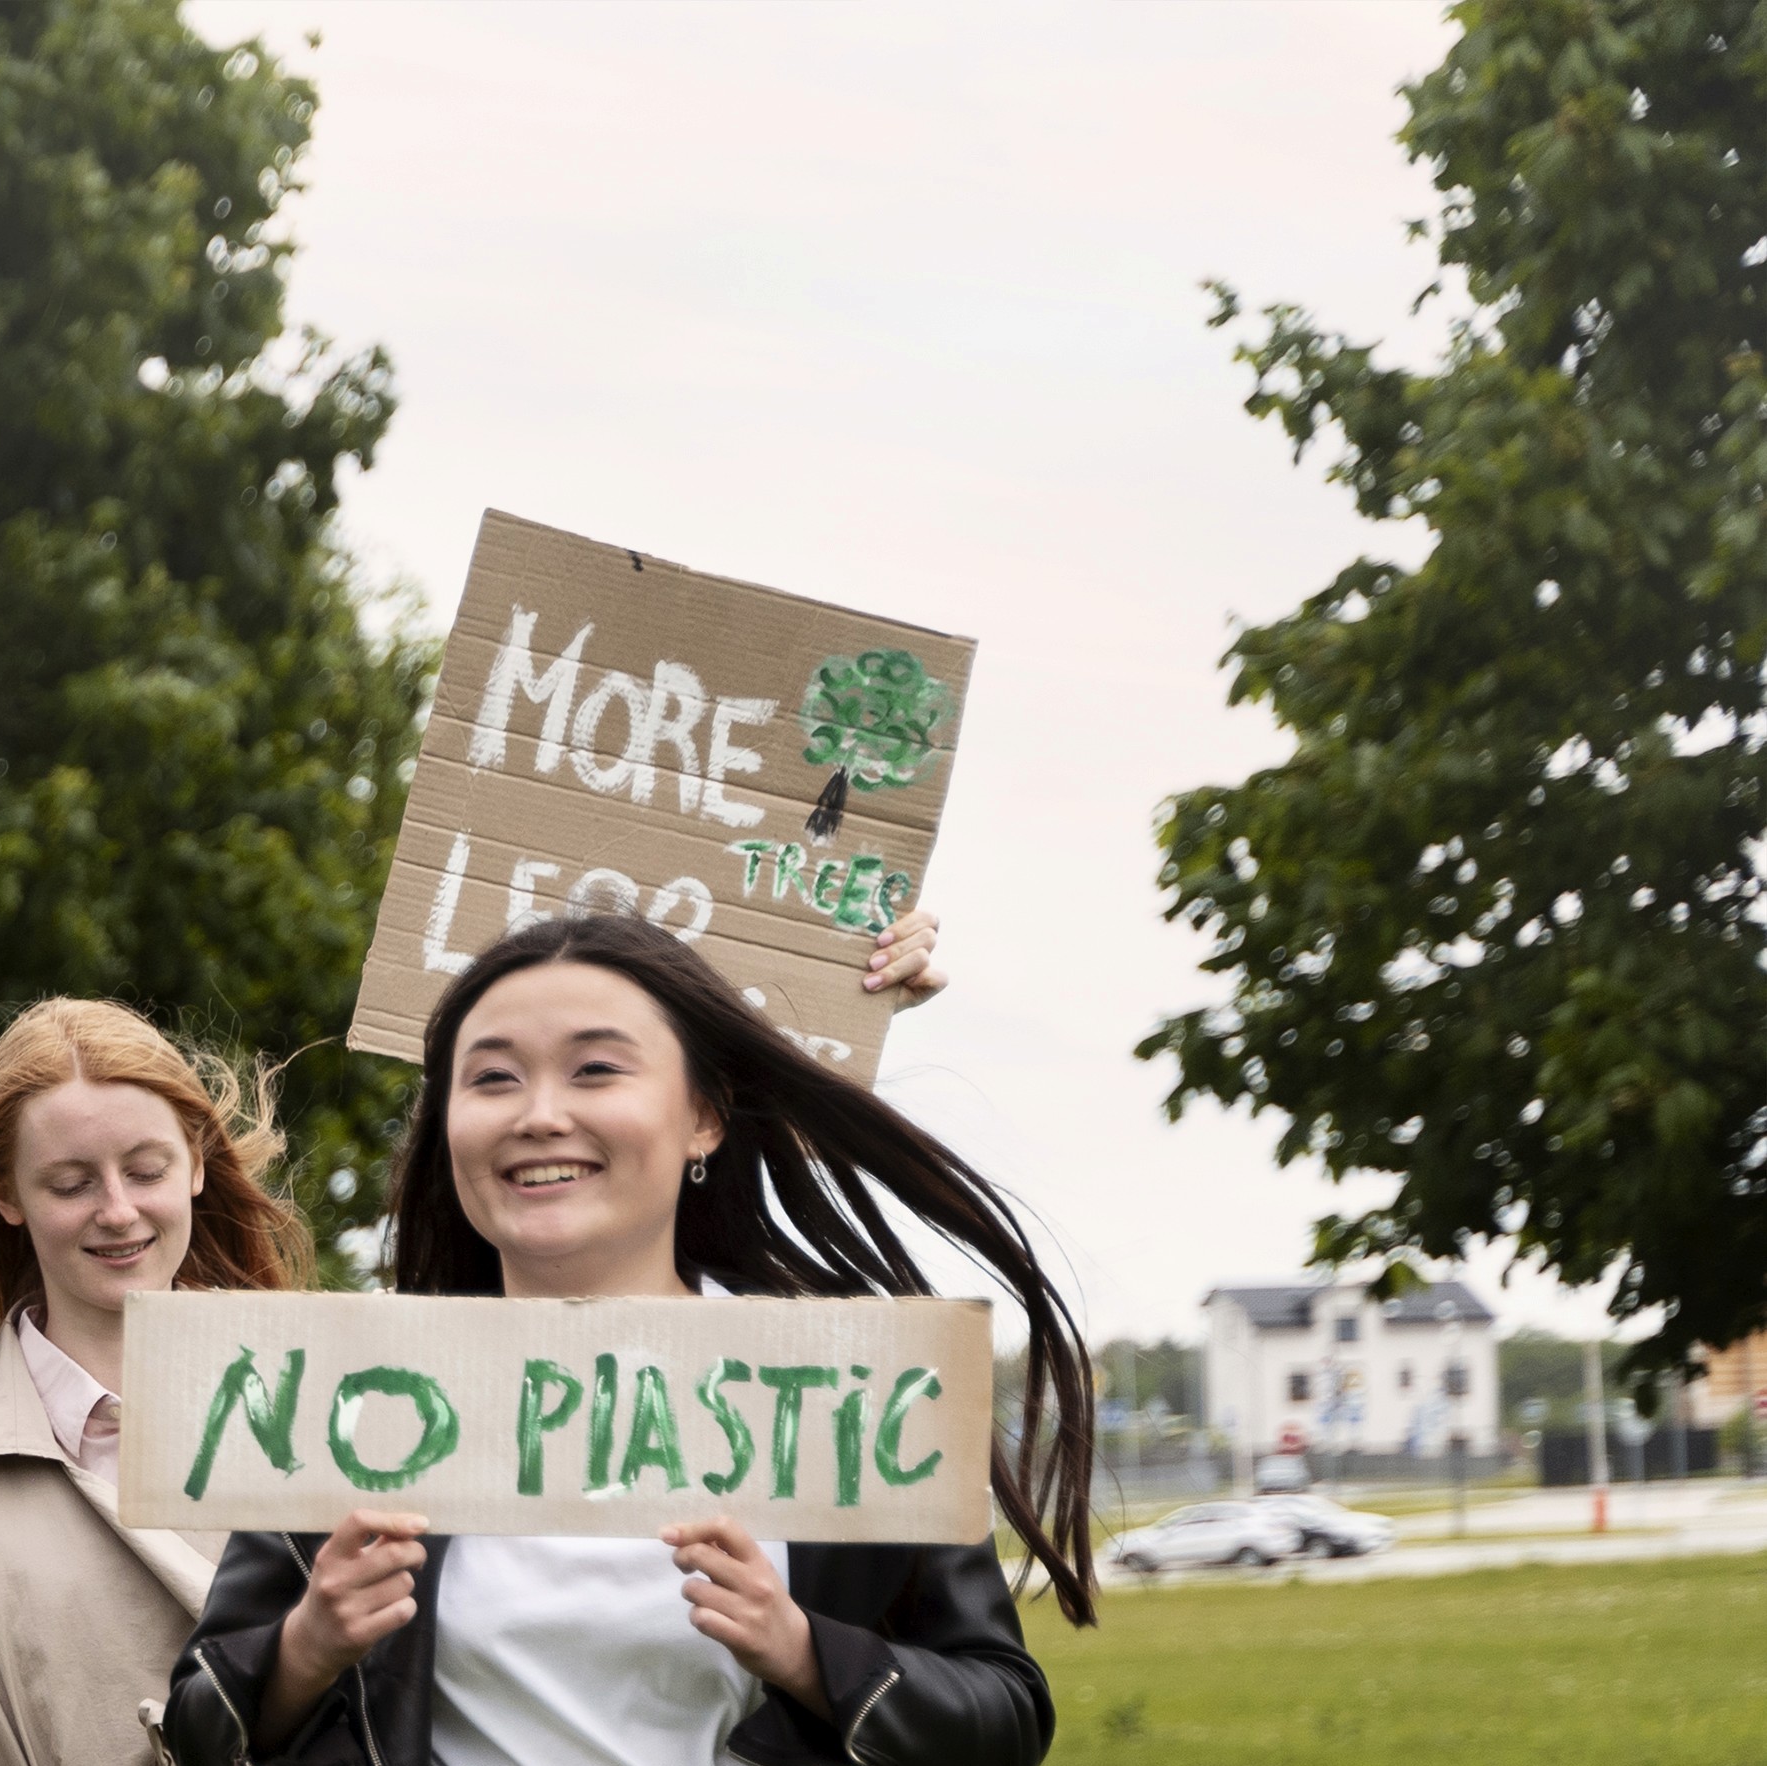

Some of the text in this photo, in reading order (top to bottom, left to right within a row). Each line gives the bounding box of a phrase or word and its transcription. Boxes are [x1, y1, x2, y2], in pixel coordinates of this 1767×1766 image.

[466, 602, 780, 829] MORE
[724, 838, 911, 938] TREES
[183, 1344, 460, 1501] NO
